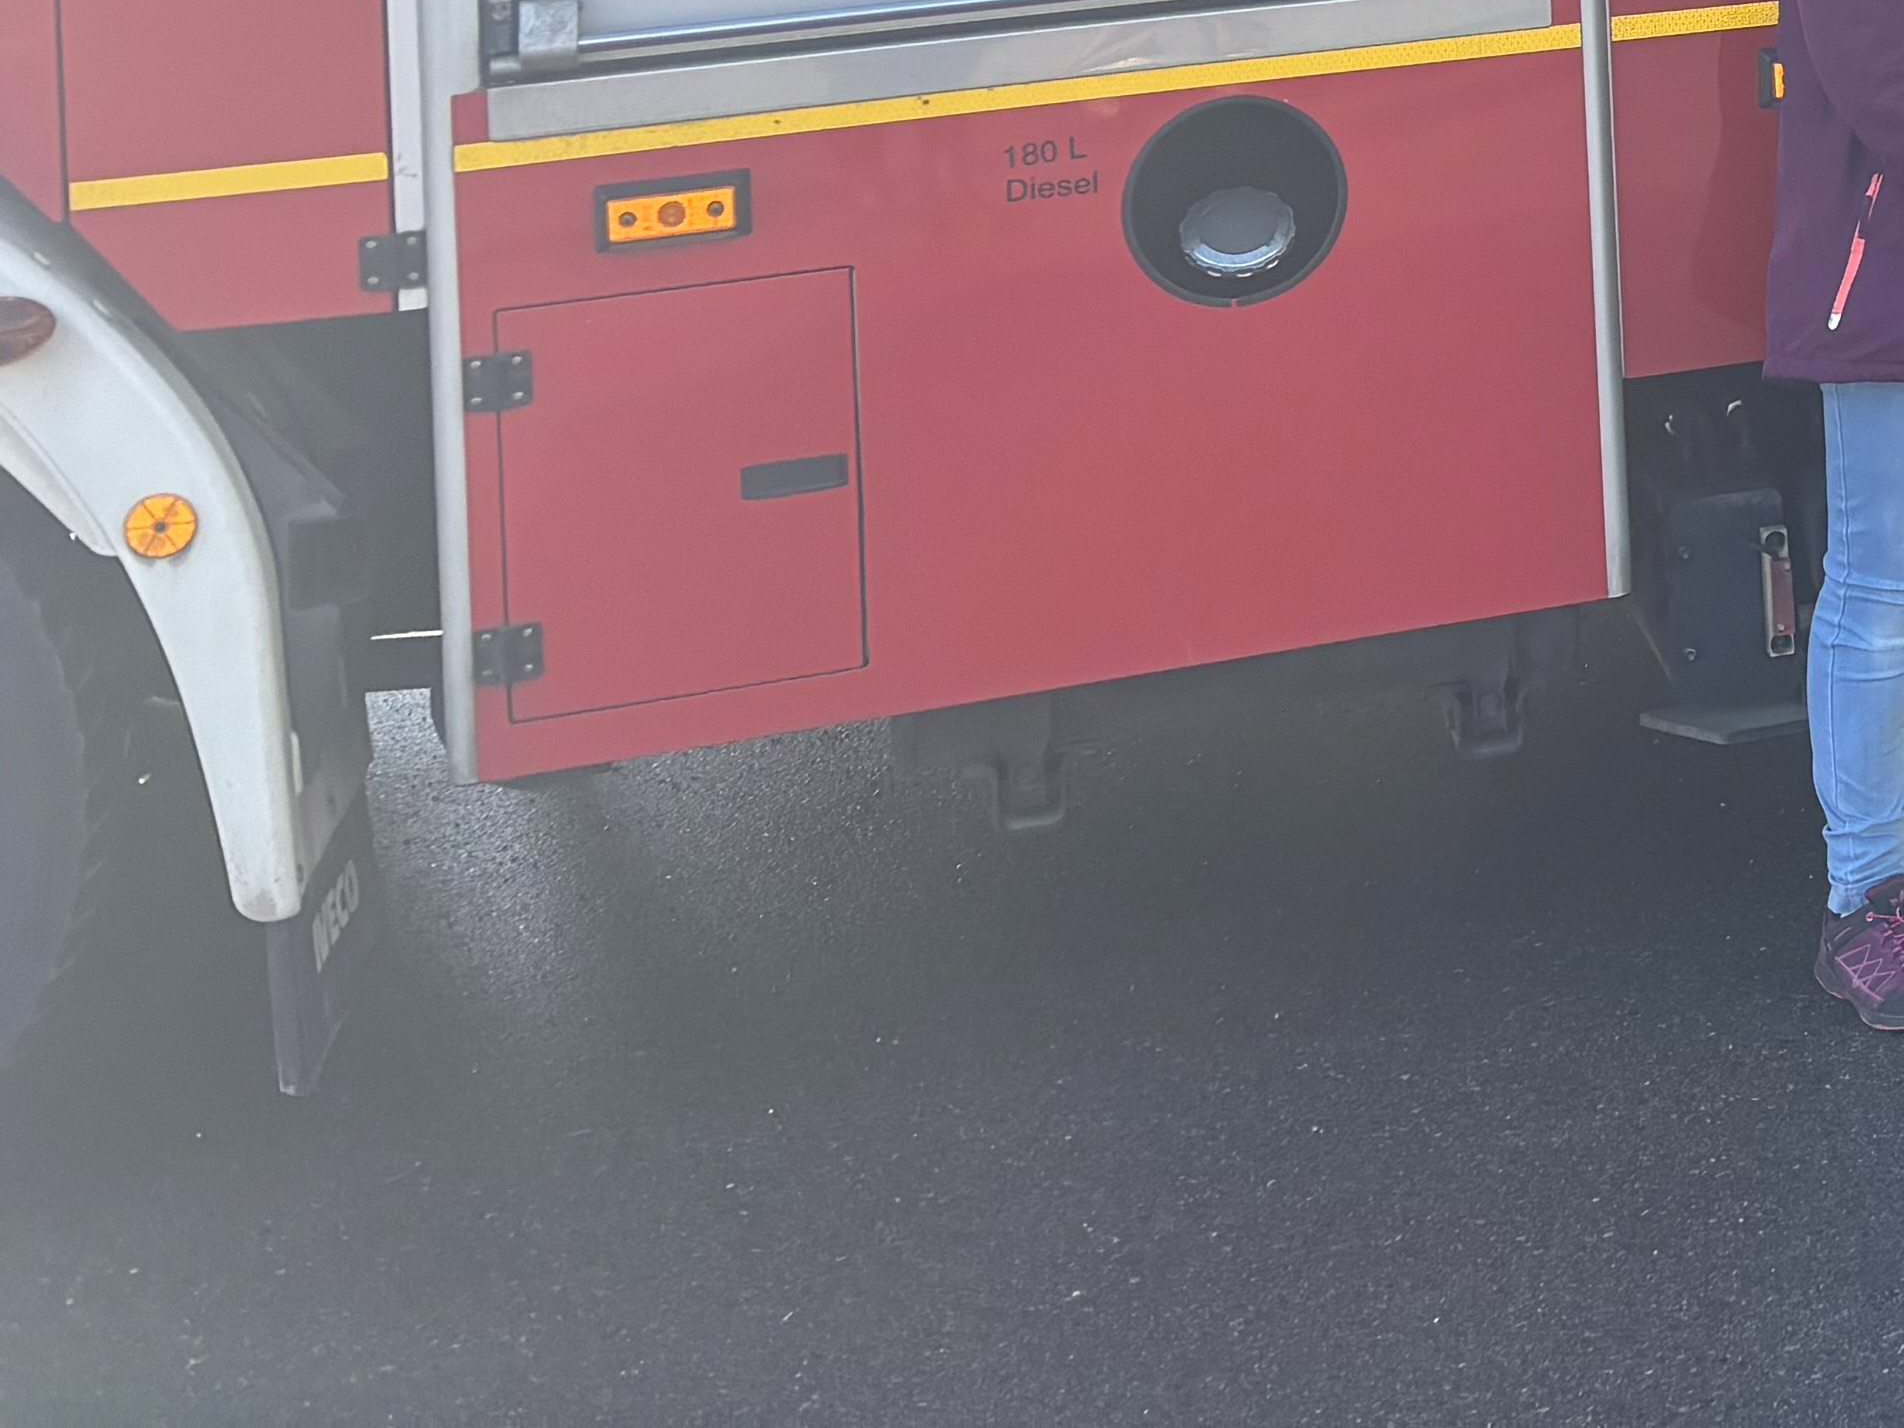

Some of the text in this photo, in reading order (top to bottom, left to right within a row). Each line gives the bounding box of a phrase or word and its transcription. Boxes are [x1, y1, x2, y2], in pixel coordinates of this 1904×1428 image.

[1004, 136, 1088, 169] 180 L
[1006, 170, 1099, 203] Diesel
